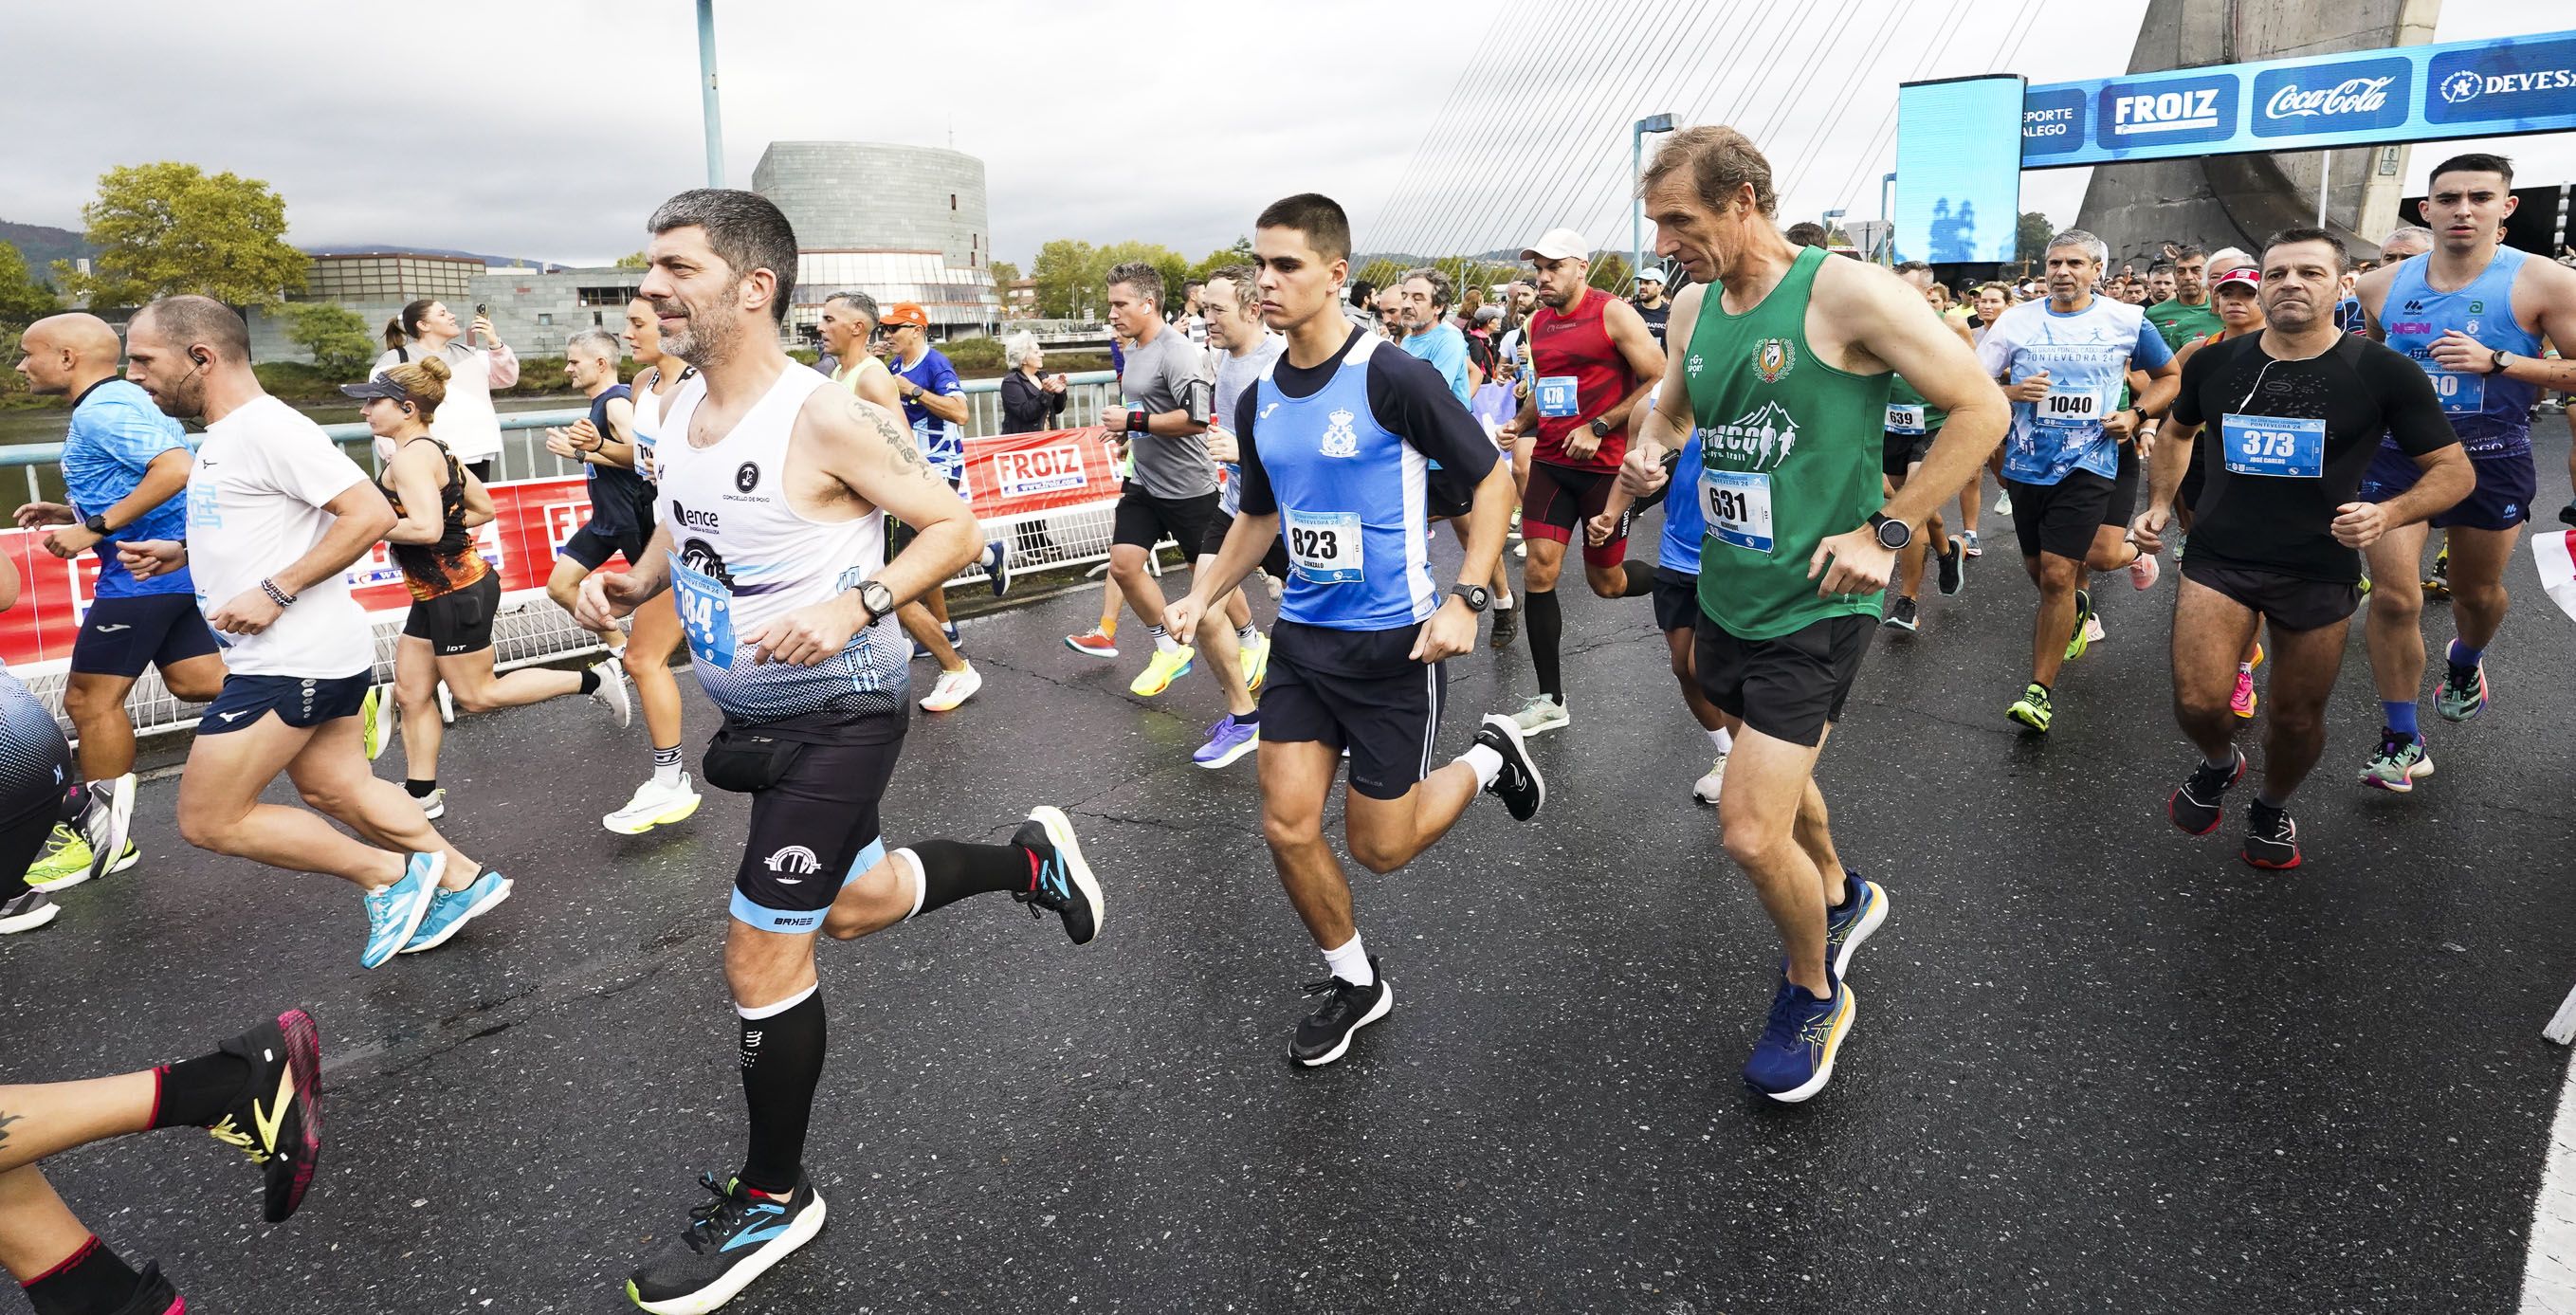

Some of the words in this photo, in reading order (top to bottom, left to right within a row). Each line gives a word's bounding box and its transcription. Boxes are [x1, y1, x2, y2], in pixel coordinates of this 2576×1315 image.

[2114, 88, 2220, 124] FROIZ
[2265, 75, 2396, 119] Coca-Cola
[2103, 354, 2114, 362] 24
[1544, 387, 1565, 405] 478
[2049, 396, 2092, 413] 1040
[1890, 411, 1913, 425] 639
[2242, 430, 2295, 457] 373
[997, 447, 1079, 483] FROIZ
[1709, 486, 1748, 522] 631
[686, 509, 719, 528] ence
[1292, 527, 1338, 559] 823
[1304, 559, 1325, 569] GONZALO
[446, 644, 467, 652] IDT
